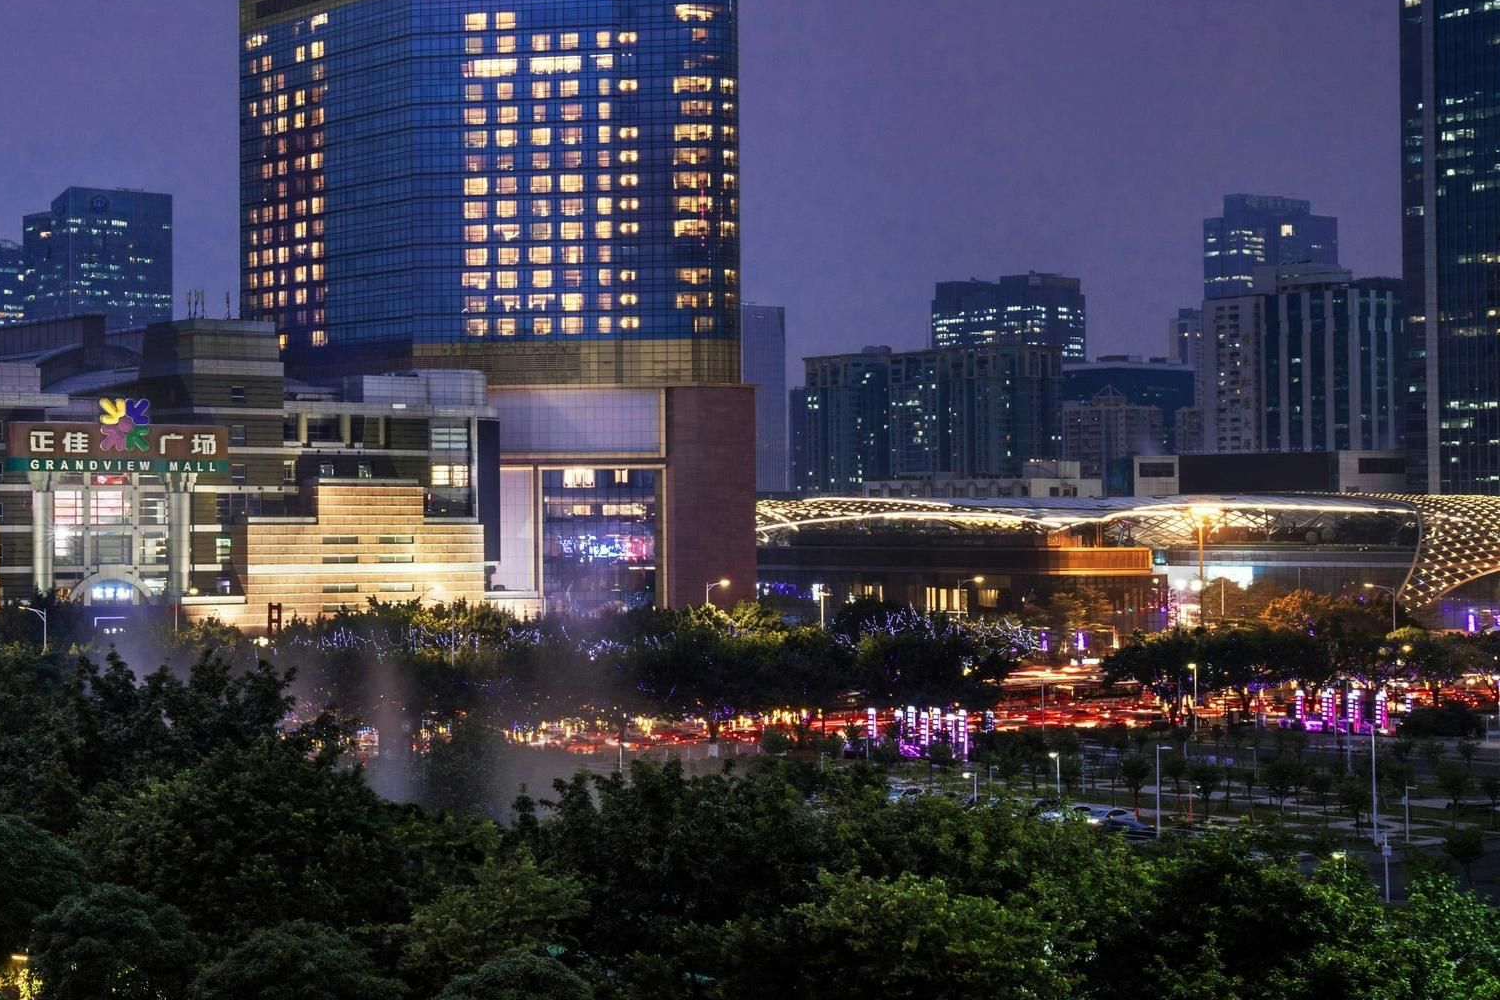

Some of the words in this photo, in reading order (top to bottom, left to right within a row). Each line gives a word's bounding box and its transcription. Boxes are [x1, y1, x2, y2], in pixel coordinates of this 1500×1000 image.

[30, 431, 88, 453] 正佳
[159, 433, 217, 455] 广场
[30, 459, 151, 471] GRANDVIEW
[169, 461, 217, 472] MALL
